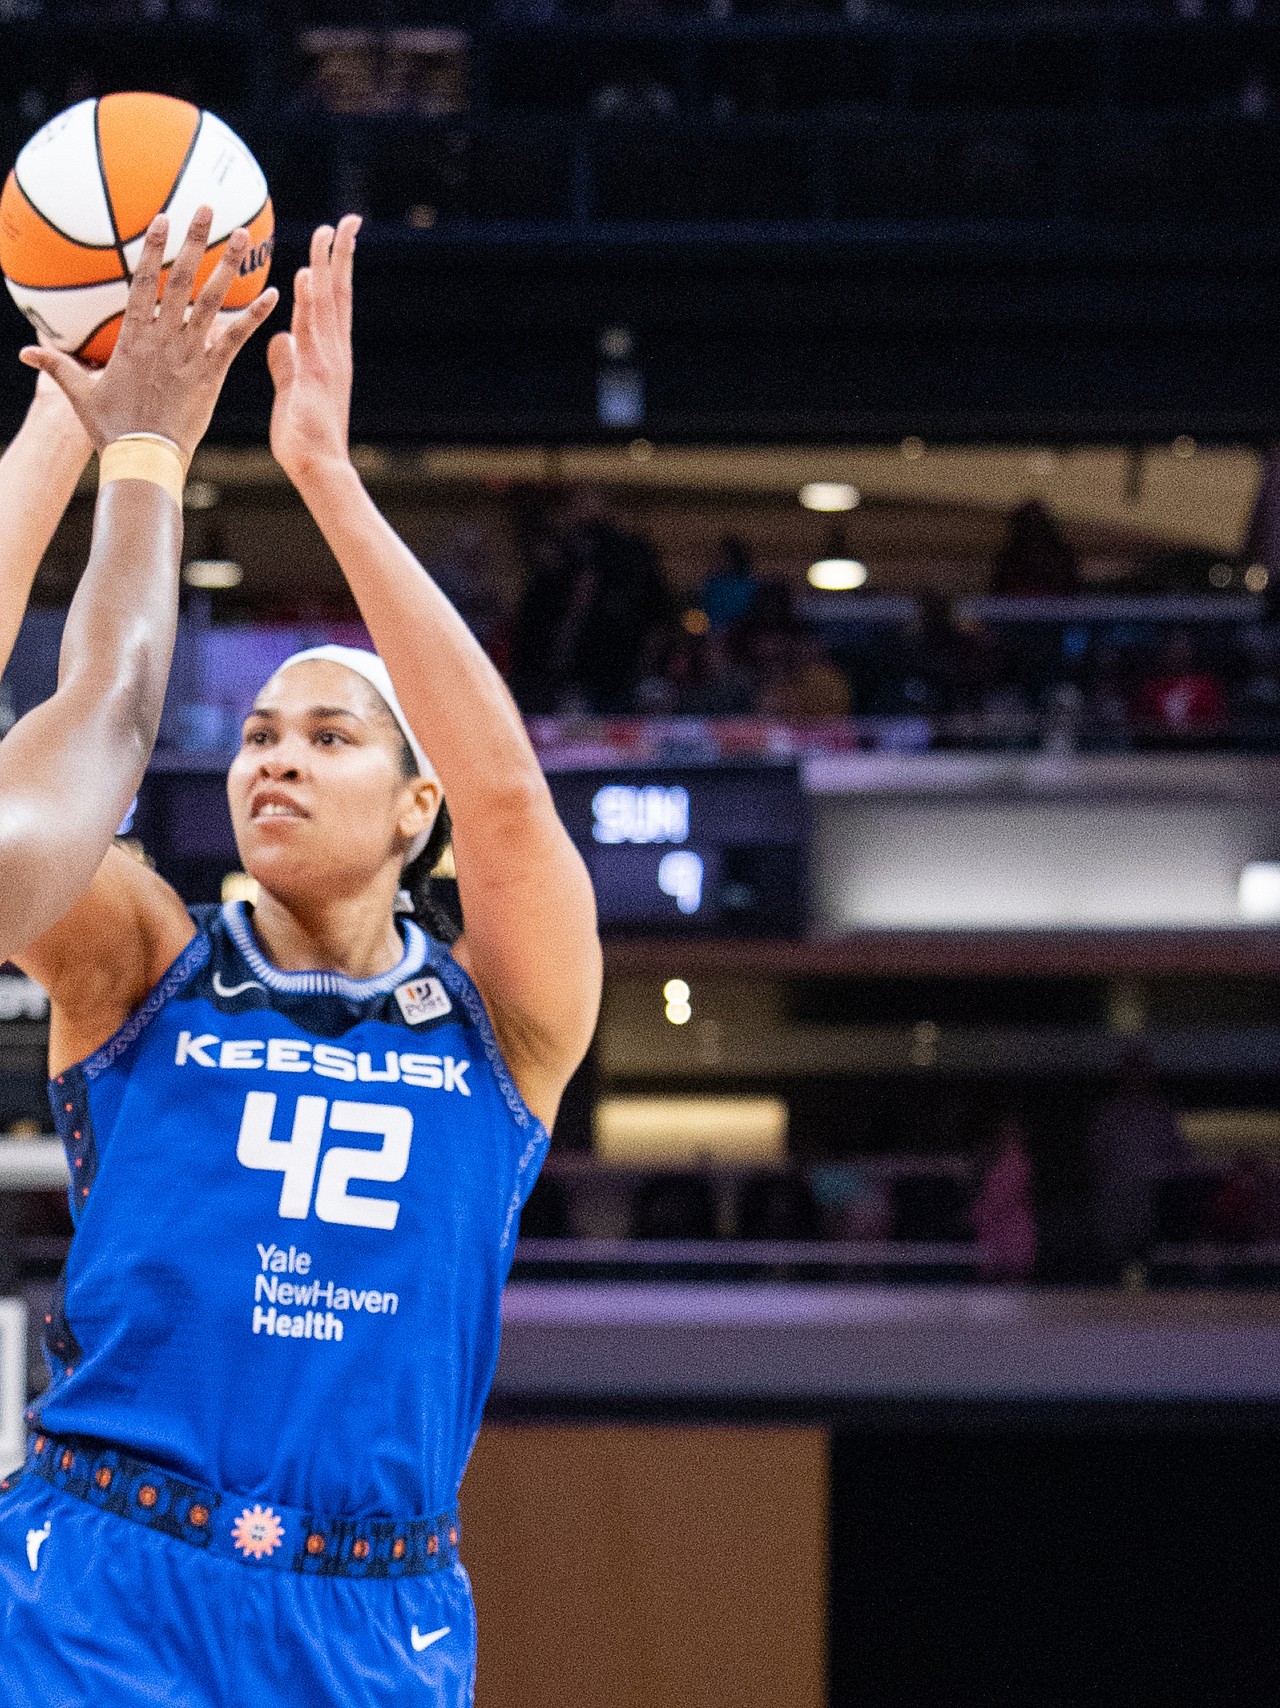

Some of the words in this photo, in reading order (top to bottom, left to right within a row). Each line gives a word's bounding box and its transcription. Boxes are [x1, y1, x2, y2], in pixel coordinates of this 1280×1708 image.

[592, 786, 690, 844] SUN
[658, 851, 704, 915] 9
[175, 1031, 471, 1096] KEESUSK
[236, 1090, 414, 1230] 42
[256, 1243, 312, 1275] Yale
[252, 1305, 343, 1342] Health
